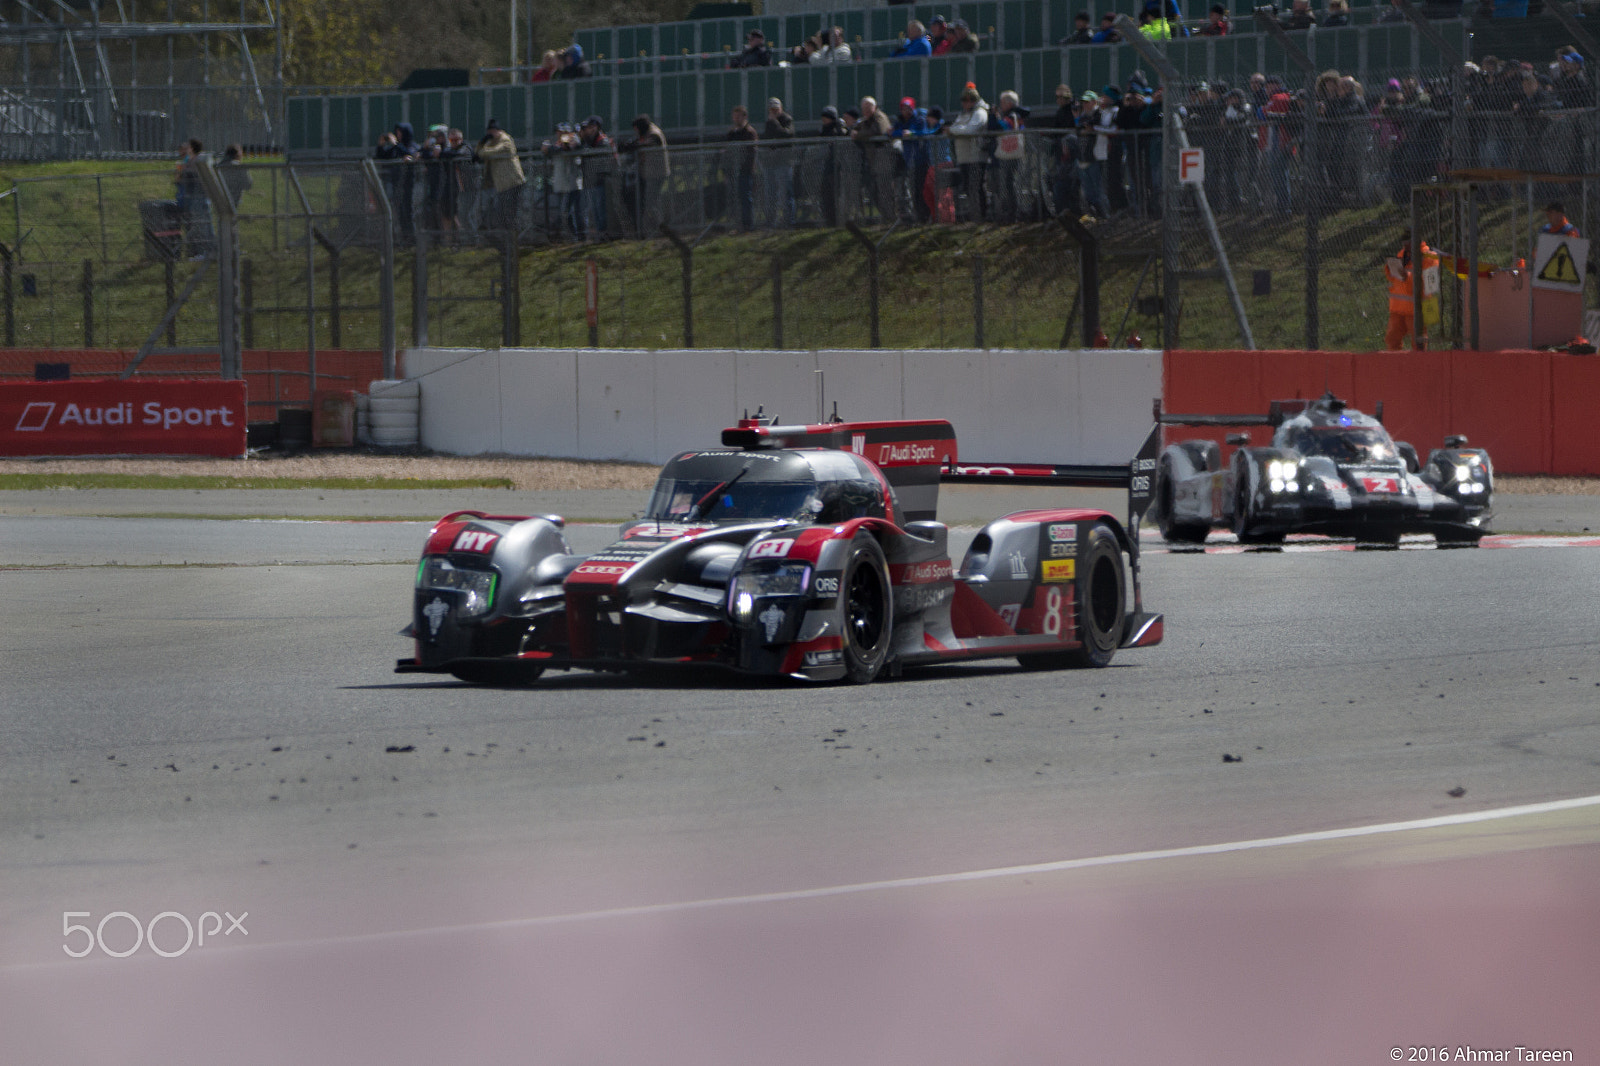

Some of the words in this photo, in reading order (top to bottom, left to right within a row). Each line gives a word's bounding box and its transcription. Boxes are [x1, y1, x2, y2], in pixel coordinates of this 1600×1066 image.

[1181, 151, 1200, 179] F
[59, 402, 133, 425] Audi
[142, 402, 234, 430] Sport
[737, 452, 781, 462] Sport
[890, 444, 911, 461] Audi
[911, 443, 935, 463] Sport
[1371, 479, 1391, 492] 2
[454, 531, 498, 551] HY
[1050, 543, 1078, 557] EDGE
[915, 564, 932, 579] Audi
[815, 577, 839, 592] ORIS
[1043, 586, 1061, 635] 8
